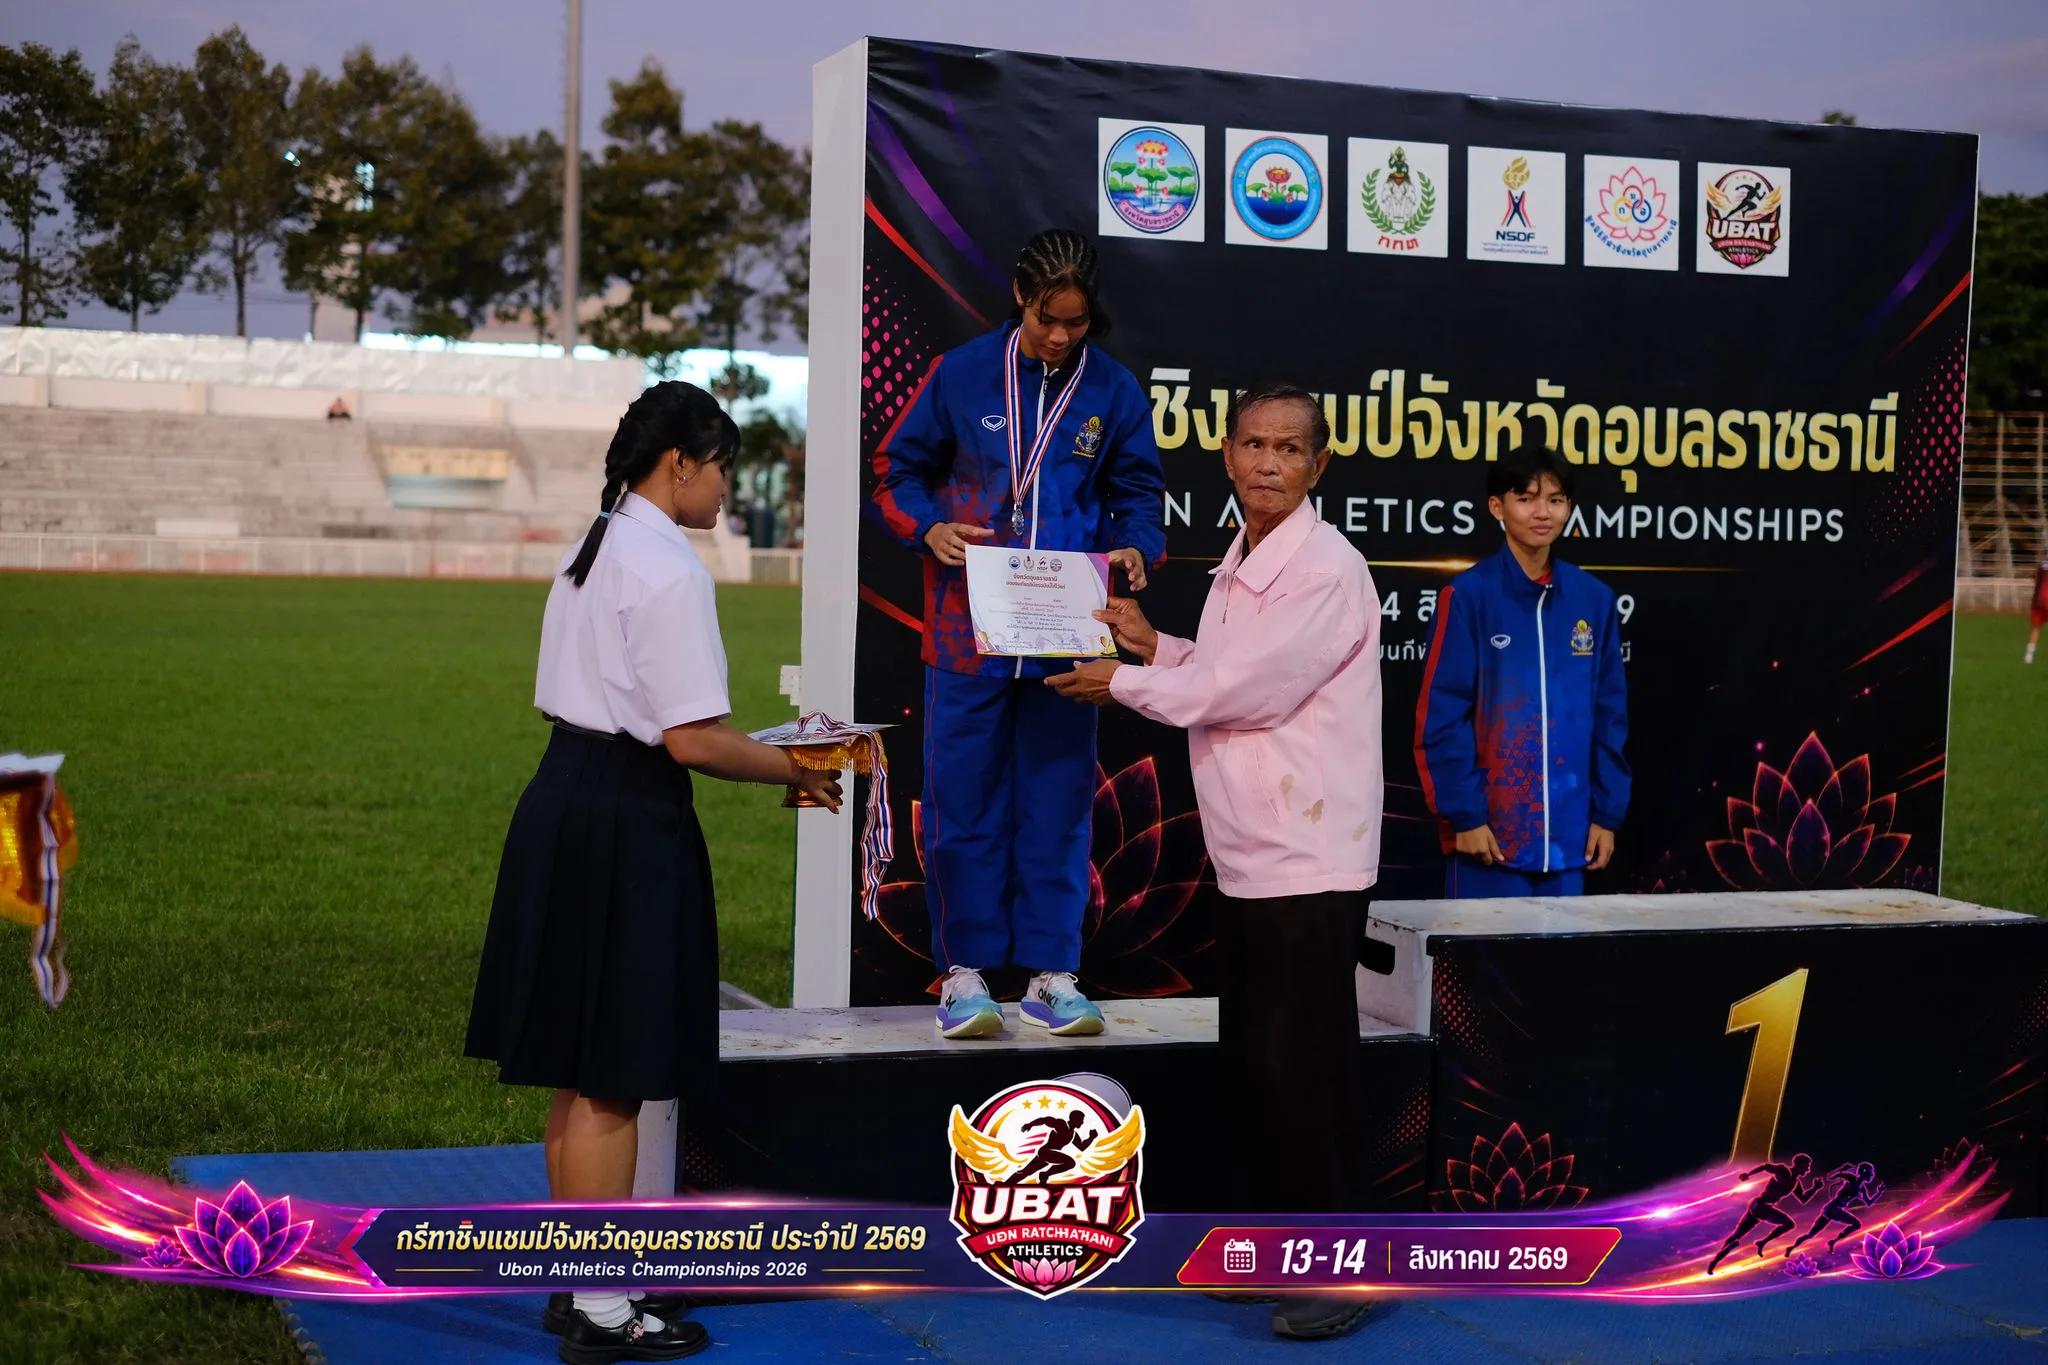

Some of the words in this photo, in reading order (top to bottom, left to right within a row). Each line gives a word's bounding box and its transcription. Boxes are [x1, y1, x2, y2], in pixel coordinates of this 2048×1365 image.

[1496, 230, 1536, 242] NSDF
[1711, 219, 1775, 242] UBAT
[1217, 492, 1475, 535] ALETICS
[1500, 504, 1845, 542] AMPIONSHIPS
[1725, 967, 1809, 1164] 1
